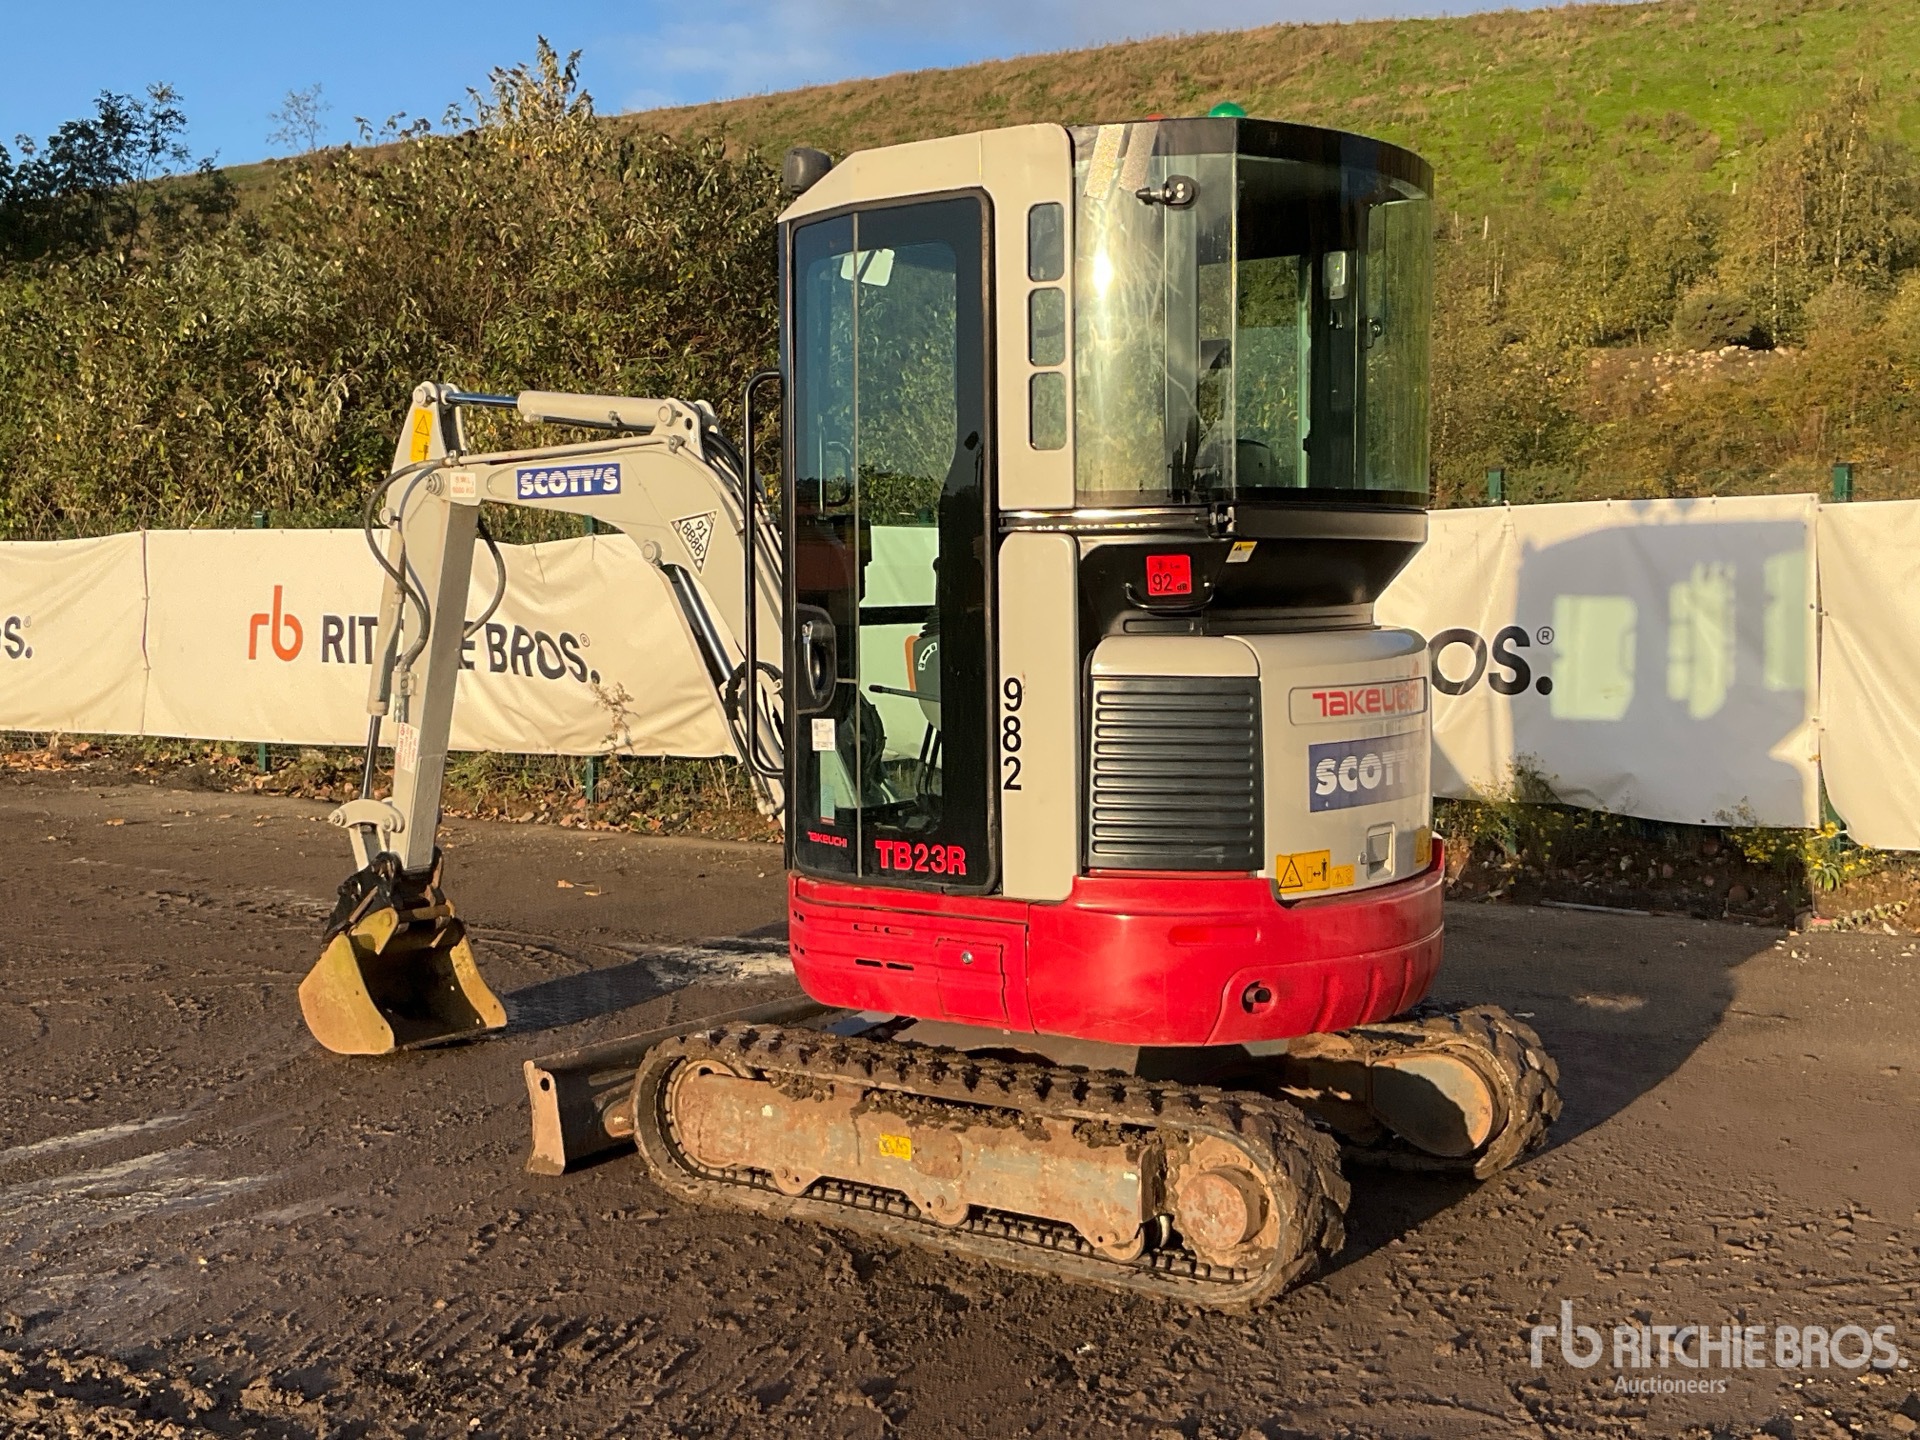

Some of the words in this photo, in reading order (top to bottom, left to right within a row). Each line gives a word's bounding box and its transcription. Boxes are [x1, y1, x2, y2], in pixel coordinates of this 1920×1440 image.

[520, 467, 618, 497] SCOTT'S
[694, 520, 708, 541] 91
[1152, 573, 1173, 592] 92
[1176, 583, 1188, 591] dB
[321, 615, 476, 671] RITE
[807, 831, 847, 848] TAKEUCHI
[874, 840, 967, 876] TB23R
